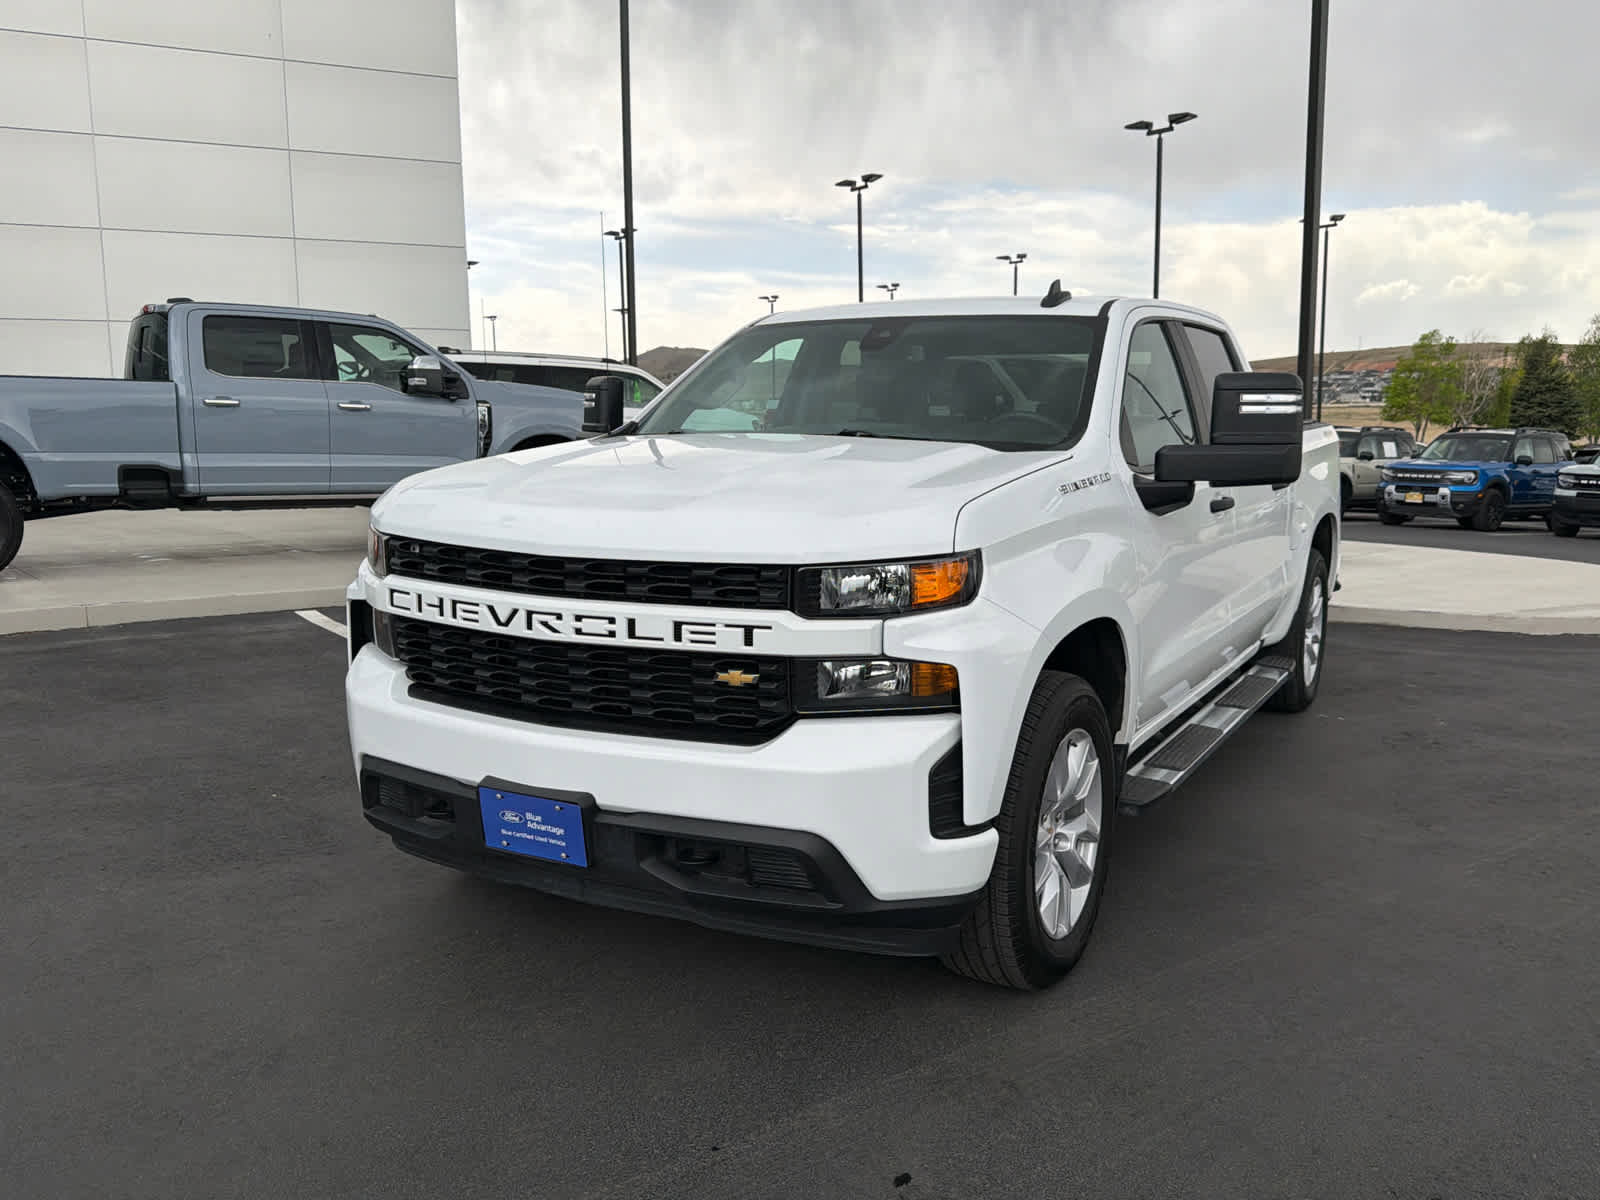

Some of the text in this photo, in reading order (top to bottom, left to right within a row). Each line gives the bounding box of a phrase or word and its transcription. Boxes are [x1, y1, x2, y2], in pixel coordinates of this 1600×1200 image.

[388, 588, 773, 647] CHEVROLET
[525, 812, 542, 823] Blue
[527, 821, 565, 835] Advantage
